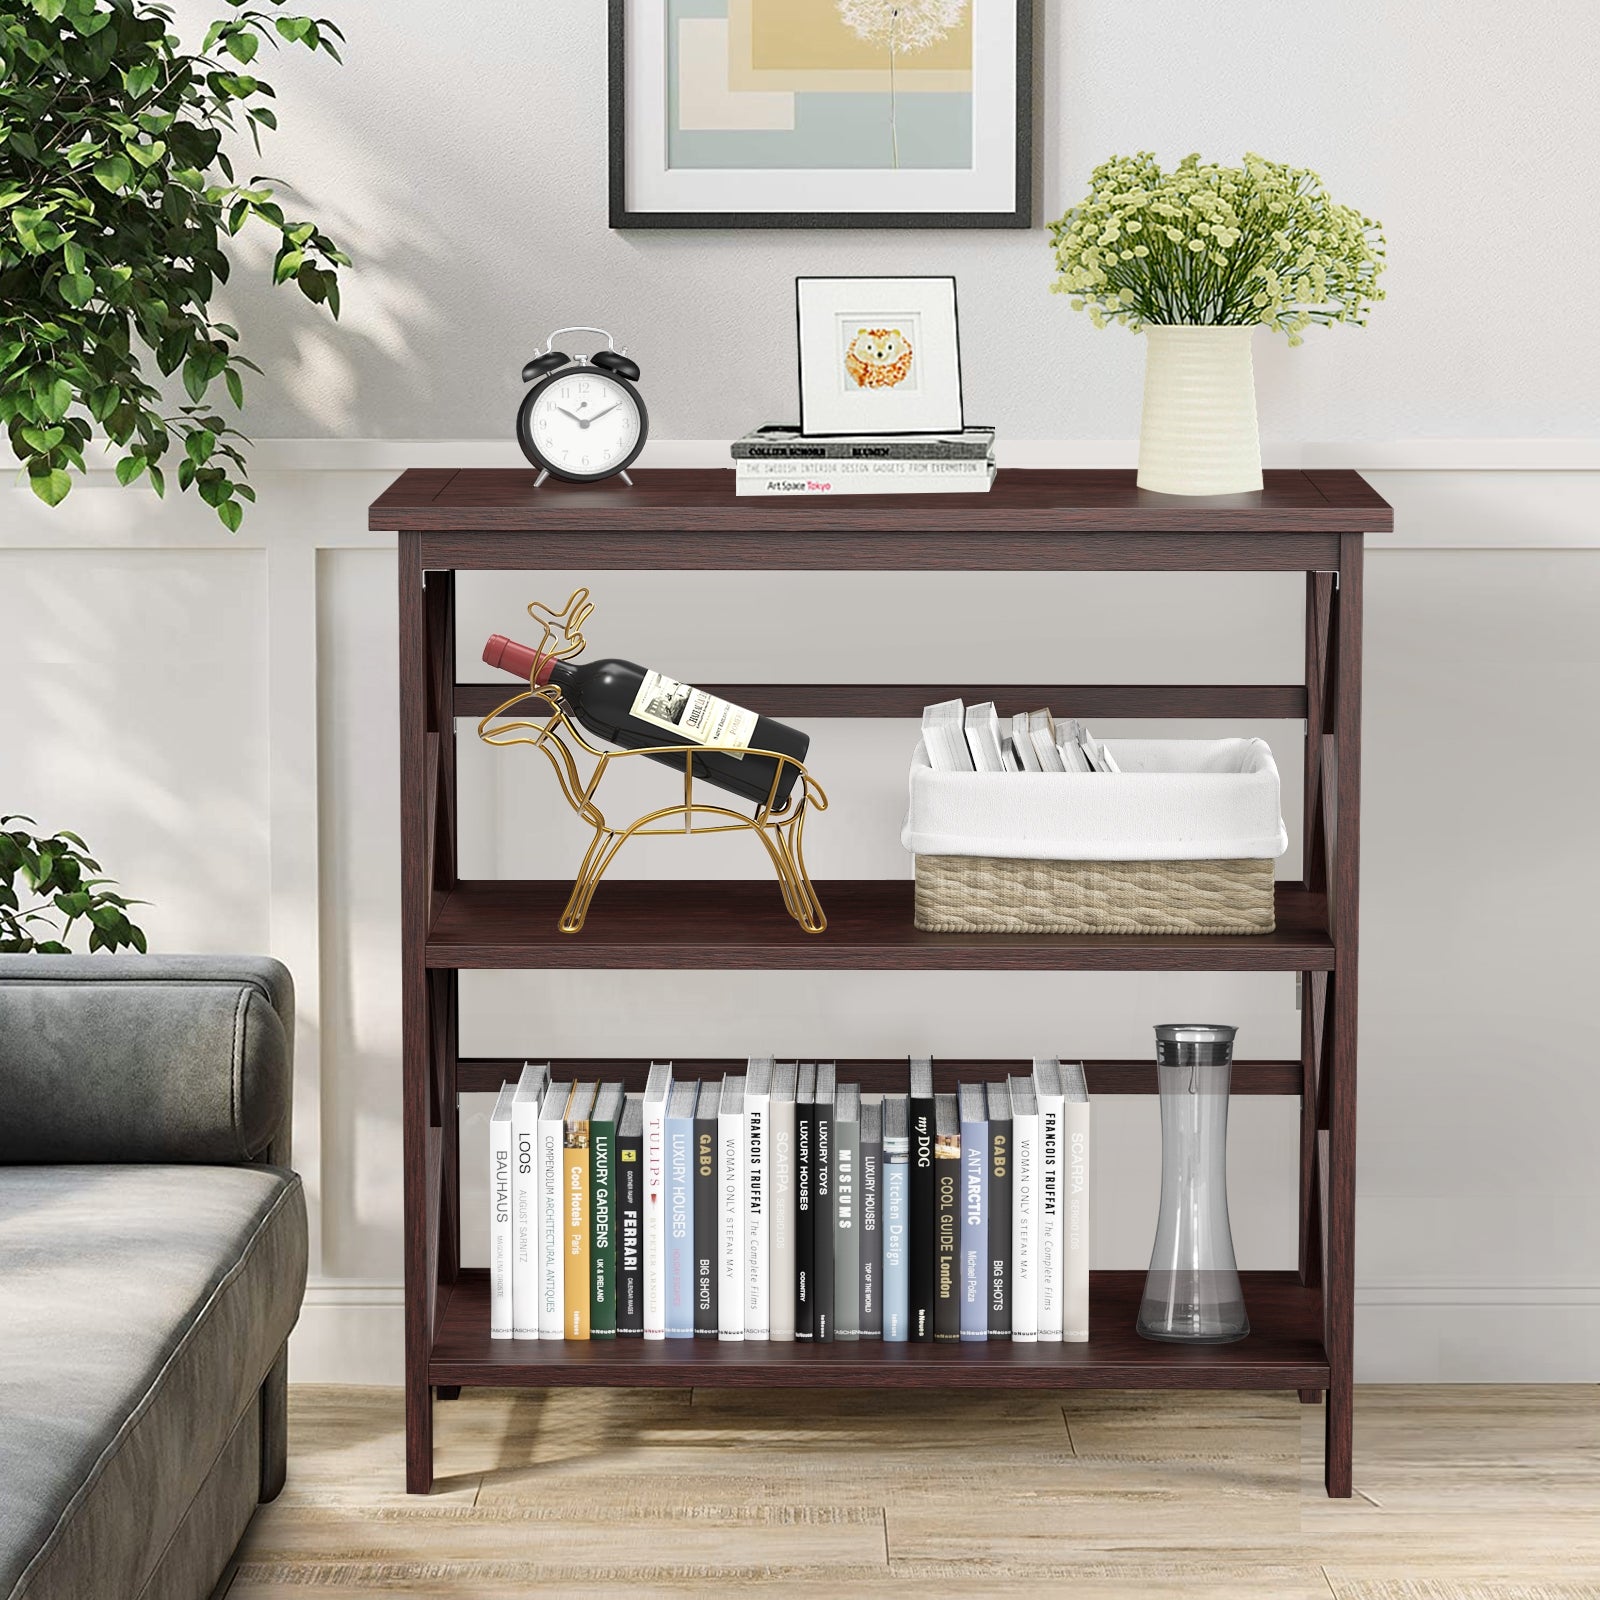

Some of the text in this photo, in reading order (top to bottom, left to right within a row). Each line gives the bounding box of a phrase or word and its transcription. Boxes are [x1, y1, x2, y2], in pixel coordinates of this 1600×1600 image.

[547, 401, 556, 412] 10
[562, 388, 570, 398] 11
[578, 383, 590, 393] 12
[539, 420, 547, 430] 9
[546, 439, 553, 448] 8
[622, 419, 629, 429] 3
[562, 450, 568, 461] 7
[582, 455, 589, 466] 6
[603, 449, 611, 460] 5
[747, 464, 763, 474] THE
[765, 464, 798, 474] SWEDISH
[800, 464, 837, 474] INTERIOR
[842, 464, 869, 474] DESIGN
[908, 463, 928, 473] FROM
[767, 480, 831, 492] Art Space Tokyo
[519, 1133, 531, 1174] LOOS
[649, 1118, 660, 1186] TULIPS
[700, 1134, 711, 1176] GABO
[726, 1139, 735, 1181] WOMAN
[799, 1121, 808, 1211] LUXURY HOUSES
[819, 1121, 827, 1195] LUXURY TOYS
[915, 1117, 930, 1167] my DOG
[994, 1135, 1005, 1177] GABO
[1020, 1140, 1029, 1182] WOMAN
[1071, 1133, 1083, 1194] SCARPA
[496, 1151, 508, 1222] BAUHAUS
[571, 1167, 582, 1255] Cool Hotels Paris
[596, 1136, 608, 1248] LUXURY GARDENS
[673, 1134, 685, 1238] LUXURY HOUSES
[726, 1186, 735, 1213] ONLY
[749, 1112, 761, 1310] FRANCOIS TRUFFAT The Complete Films
[776, 1132, 789, 1248] SCARPA SERGIO LOS
[839, 1150, 851, 1229] MUSEUMS
[865, 1157, 875, 1231] LUXURY HOUSES
[967, 1149, 981, 1225] ANTARCTIC
[1020, 1187, 1029, 1215] ONLY
[519, 1190, 527, 1263] AUGUST SARNITZ
[545, 1136, 555, 1313] COMPENDIUM ARCHITECTURAL ANTIQUES
[887, 1173, 902, 1266] Kitchen Design
[1043, 1113, 1055, 1311] FRANCOIS TRUFFAT The Complete Films
[624, 1211, 637, 1270] FERRARI
[649, 1234, 657, 1266] PETER
[940, 1177, 953, 1298] COOL GUIDE London
[597, 1259, 604, 1268] UK
[700, 1259, 710, 1310] BIG SHOTS
[967, 1251, 977, 1302] Michael Poliza
[993, 1260, 1003, 1311] BIG SHOTS
[649, 1271, 657, 1313] ARNOLD
